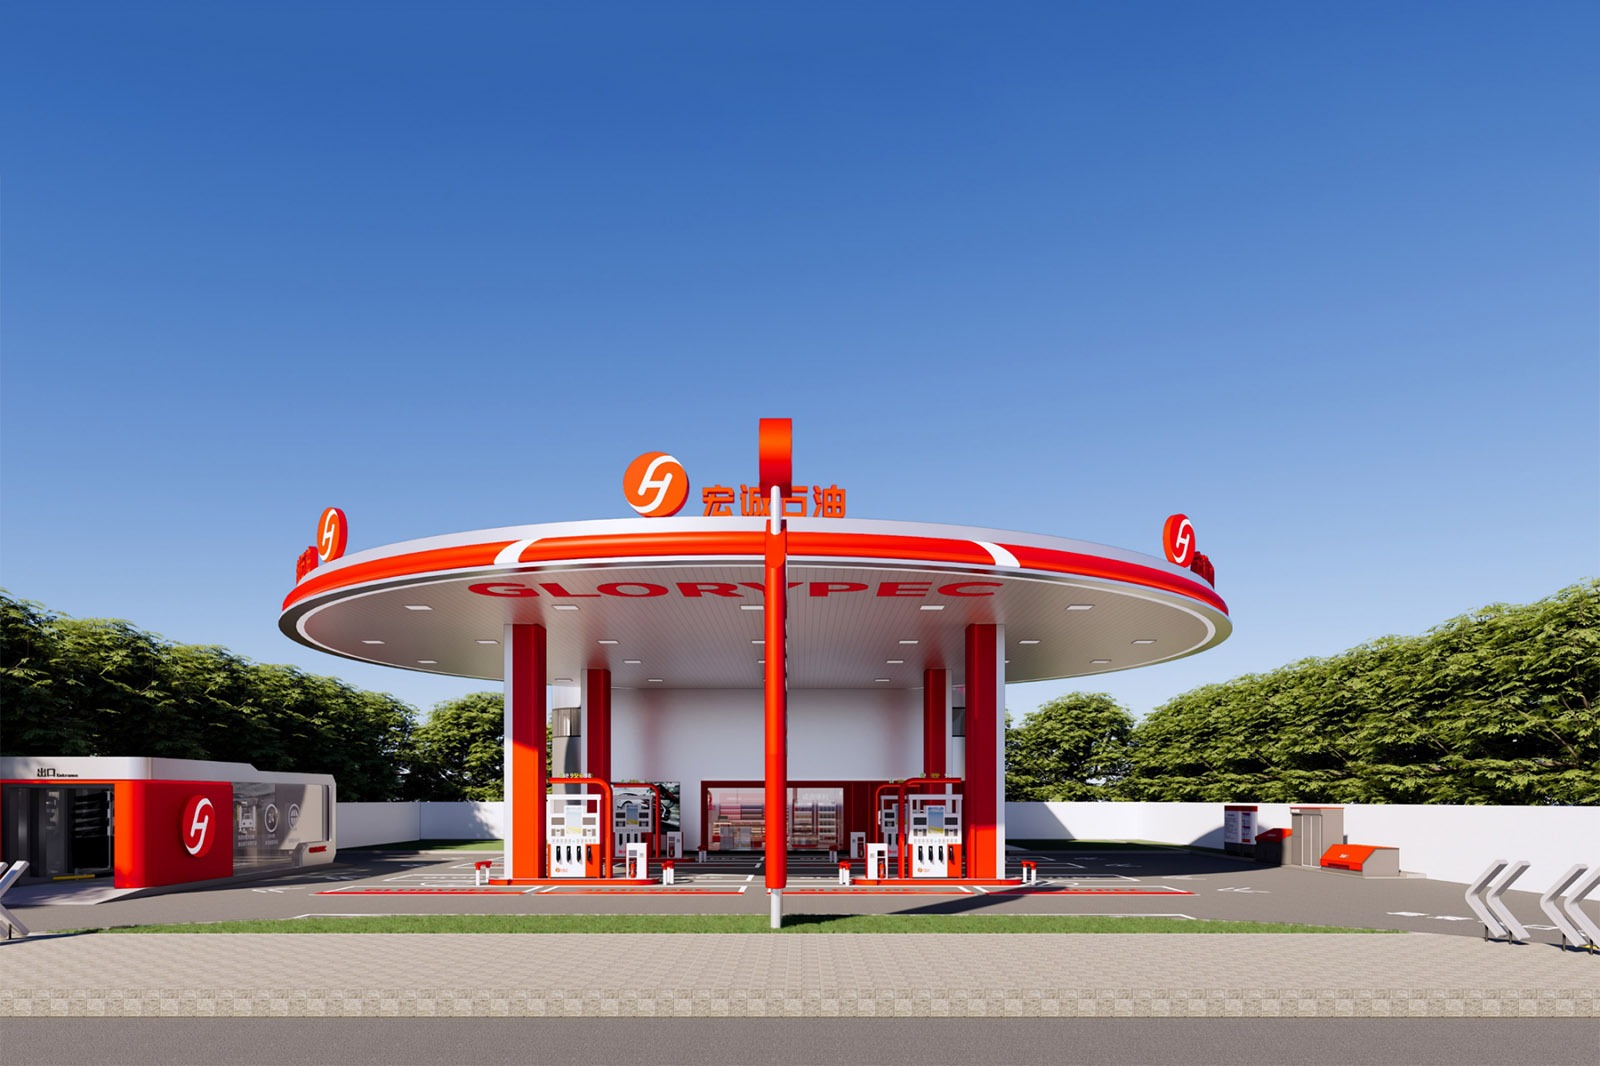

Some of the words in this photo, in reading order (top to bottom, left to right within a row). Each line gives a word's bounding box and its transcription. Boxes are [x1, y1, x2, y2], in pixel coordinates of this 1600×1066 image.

[702, 484, 846, 519] 宏诚石油
[37, 768, 56, 777] 出口
